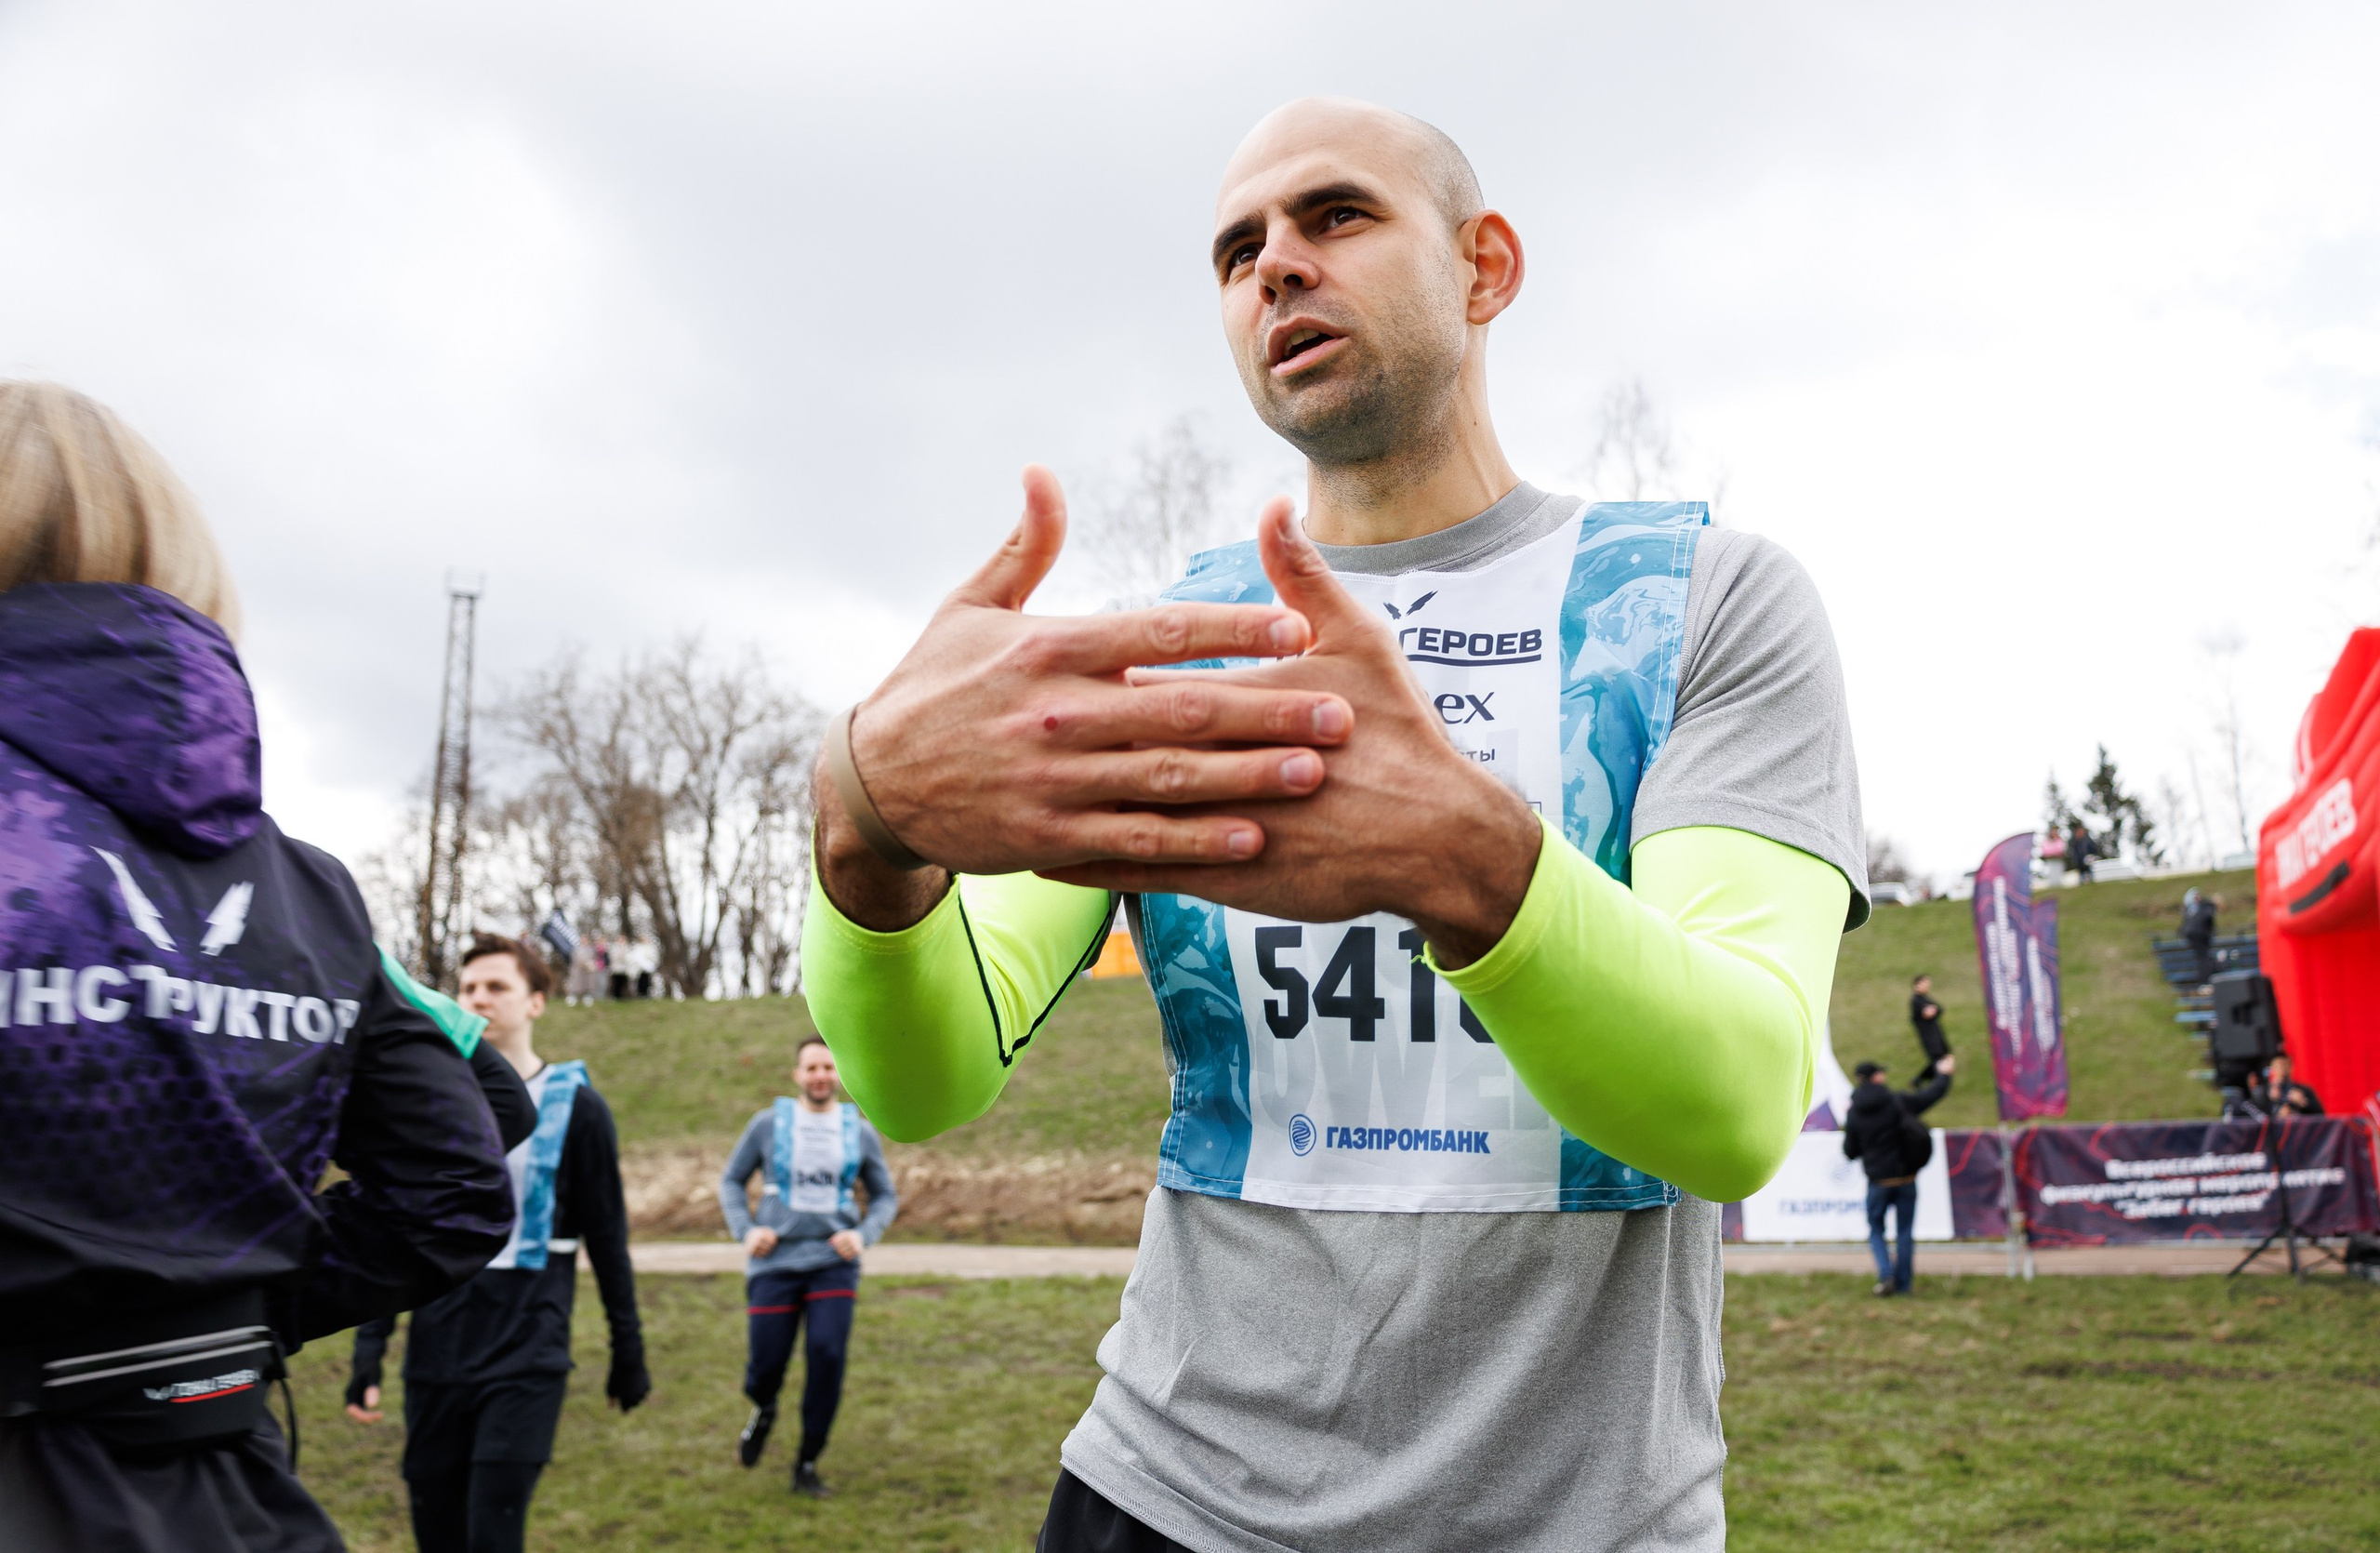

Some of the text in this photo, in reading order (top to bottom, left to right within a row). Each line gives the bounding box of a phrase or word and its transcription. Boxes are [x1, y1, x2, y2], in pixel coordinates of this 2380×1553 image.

[1399, 627, 1542, 657] ГЕРОЕВ
[1430, 691, 1495, 724] ex
[0, 964, 361, 1044] НСТРУКТОР
[1326, 1126, 1491, 1154] ГАЗПРОМБАНК
